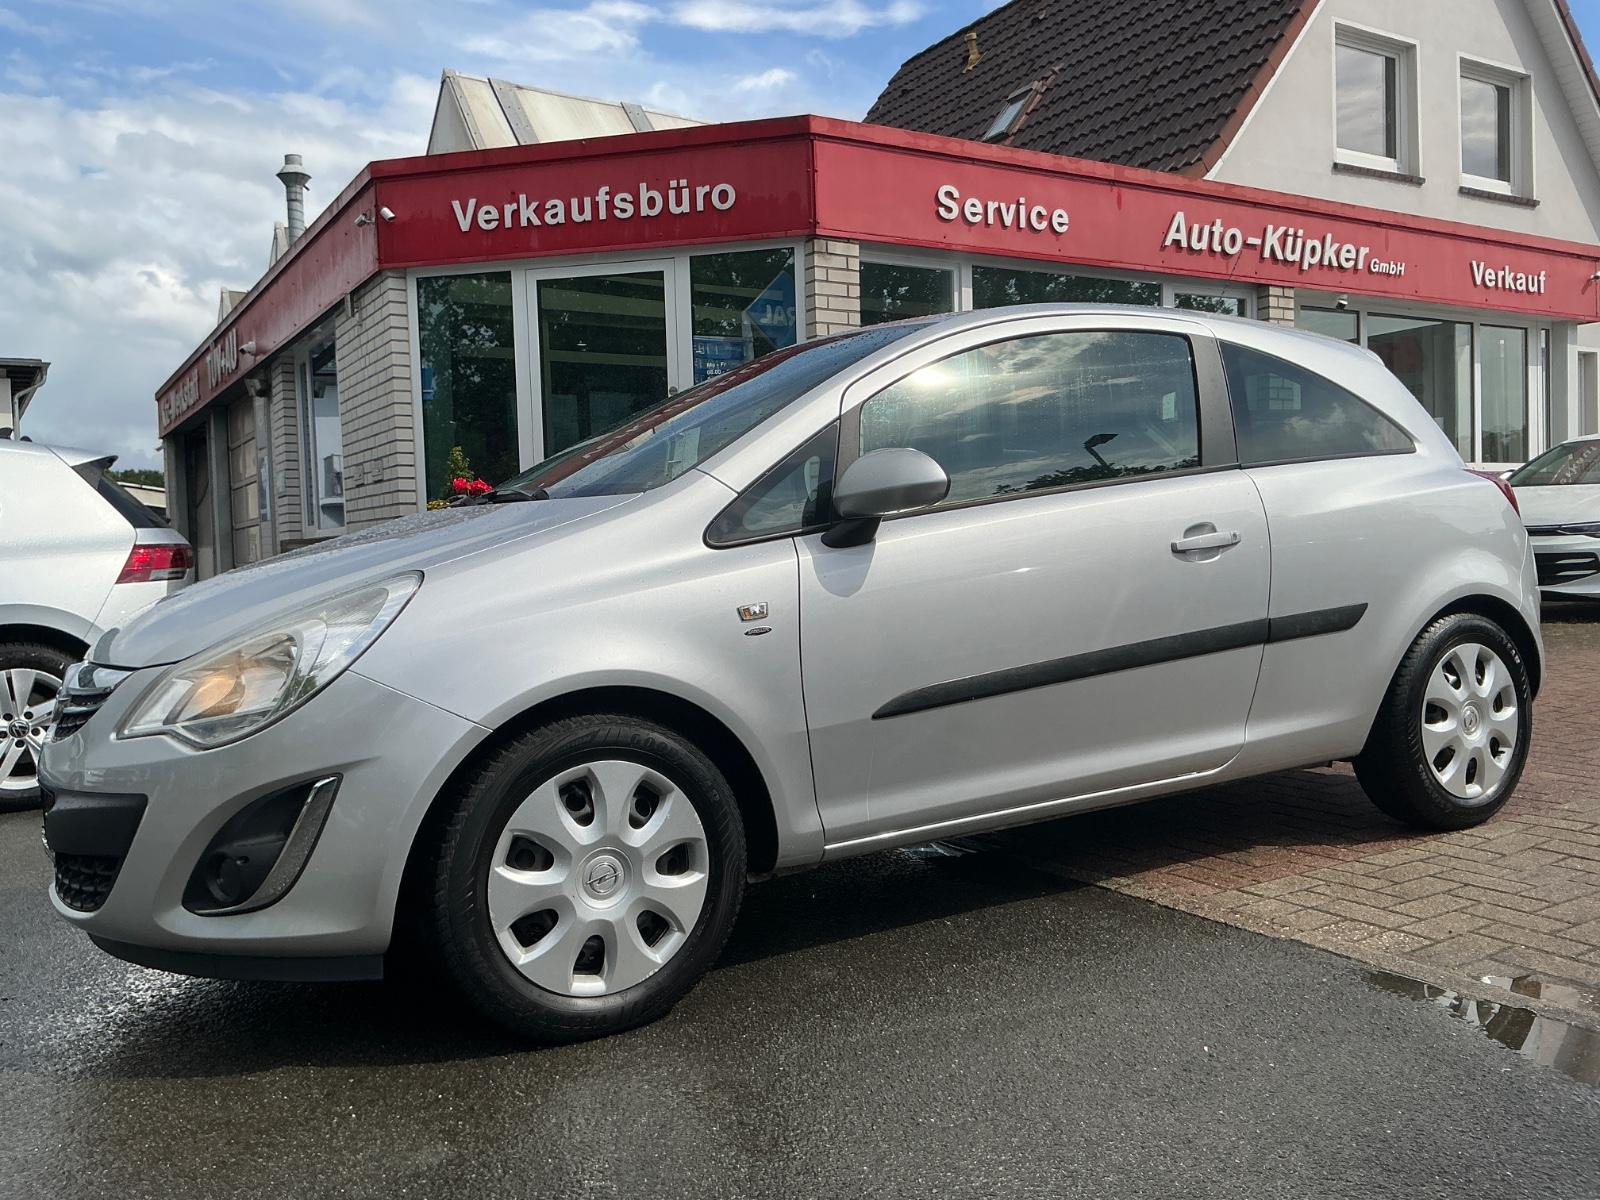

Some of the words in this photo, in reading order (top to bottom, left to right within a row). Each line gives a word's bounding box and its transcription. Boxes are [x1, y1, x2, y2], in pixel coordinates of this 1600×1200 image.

[451, 179, 737, 233] Verkaufsbüro
[937, 184, 1070, 234] Service
[1164, 211, 1370, 271] Auto-Küpker
[1370, 258, 1406, 276] GmbH
[1471, 260, 1547, 294] Verkauf
